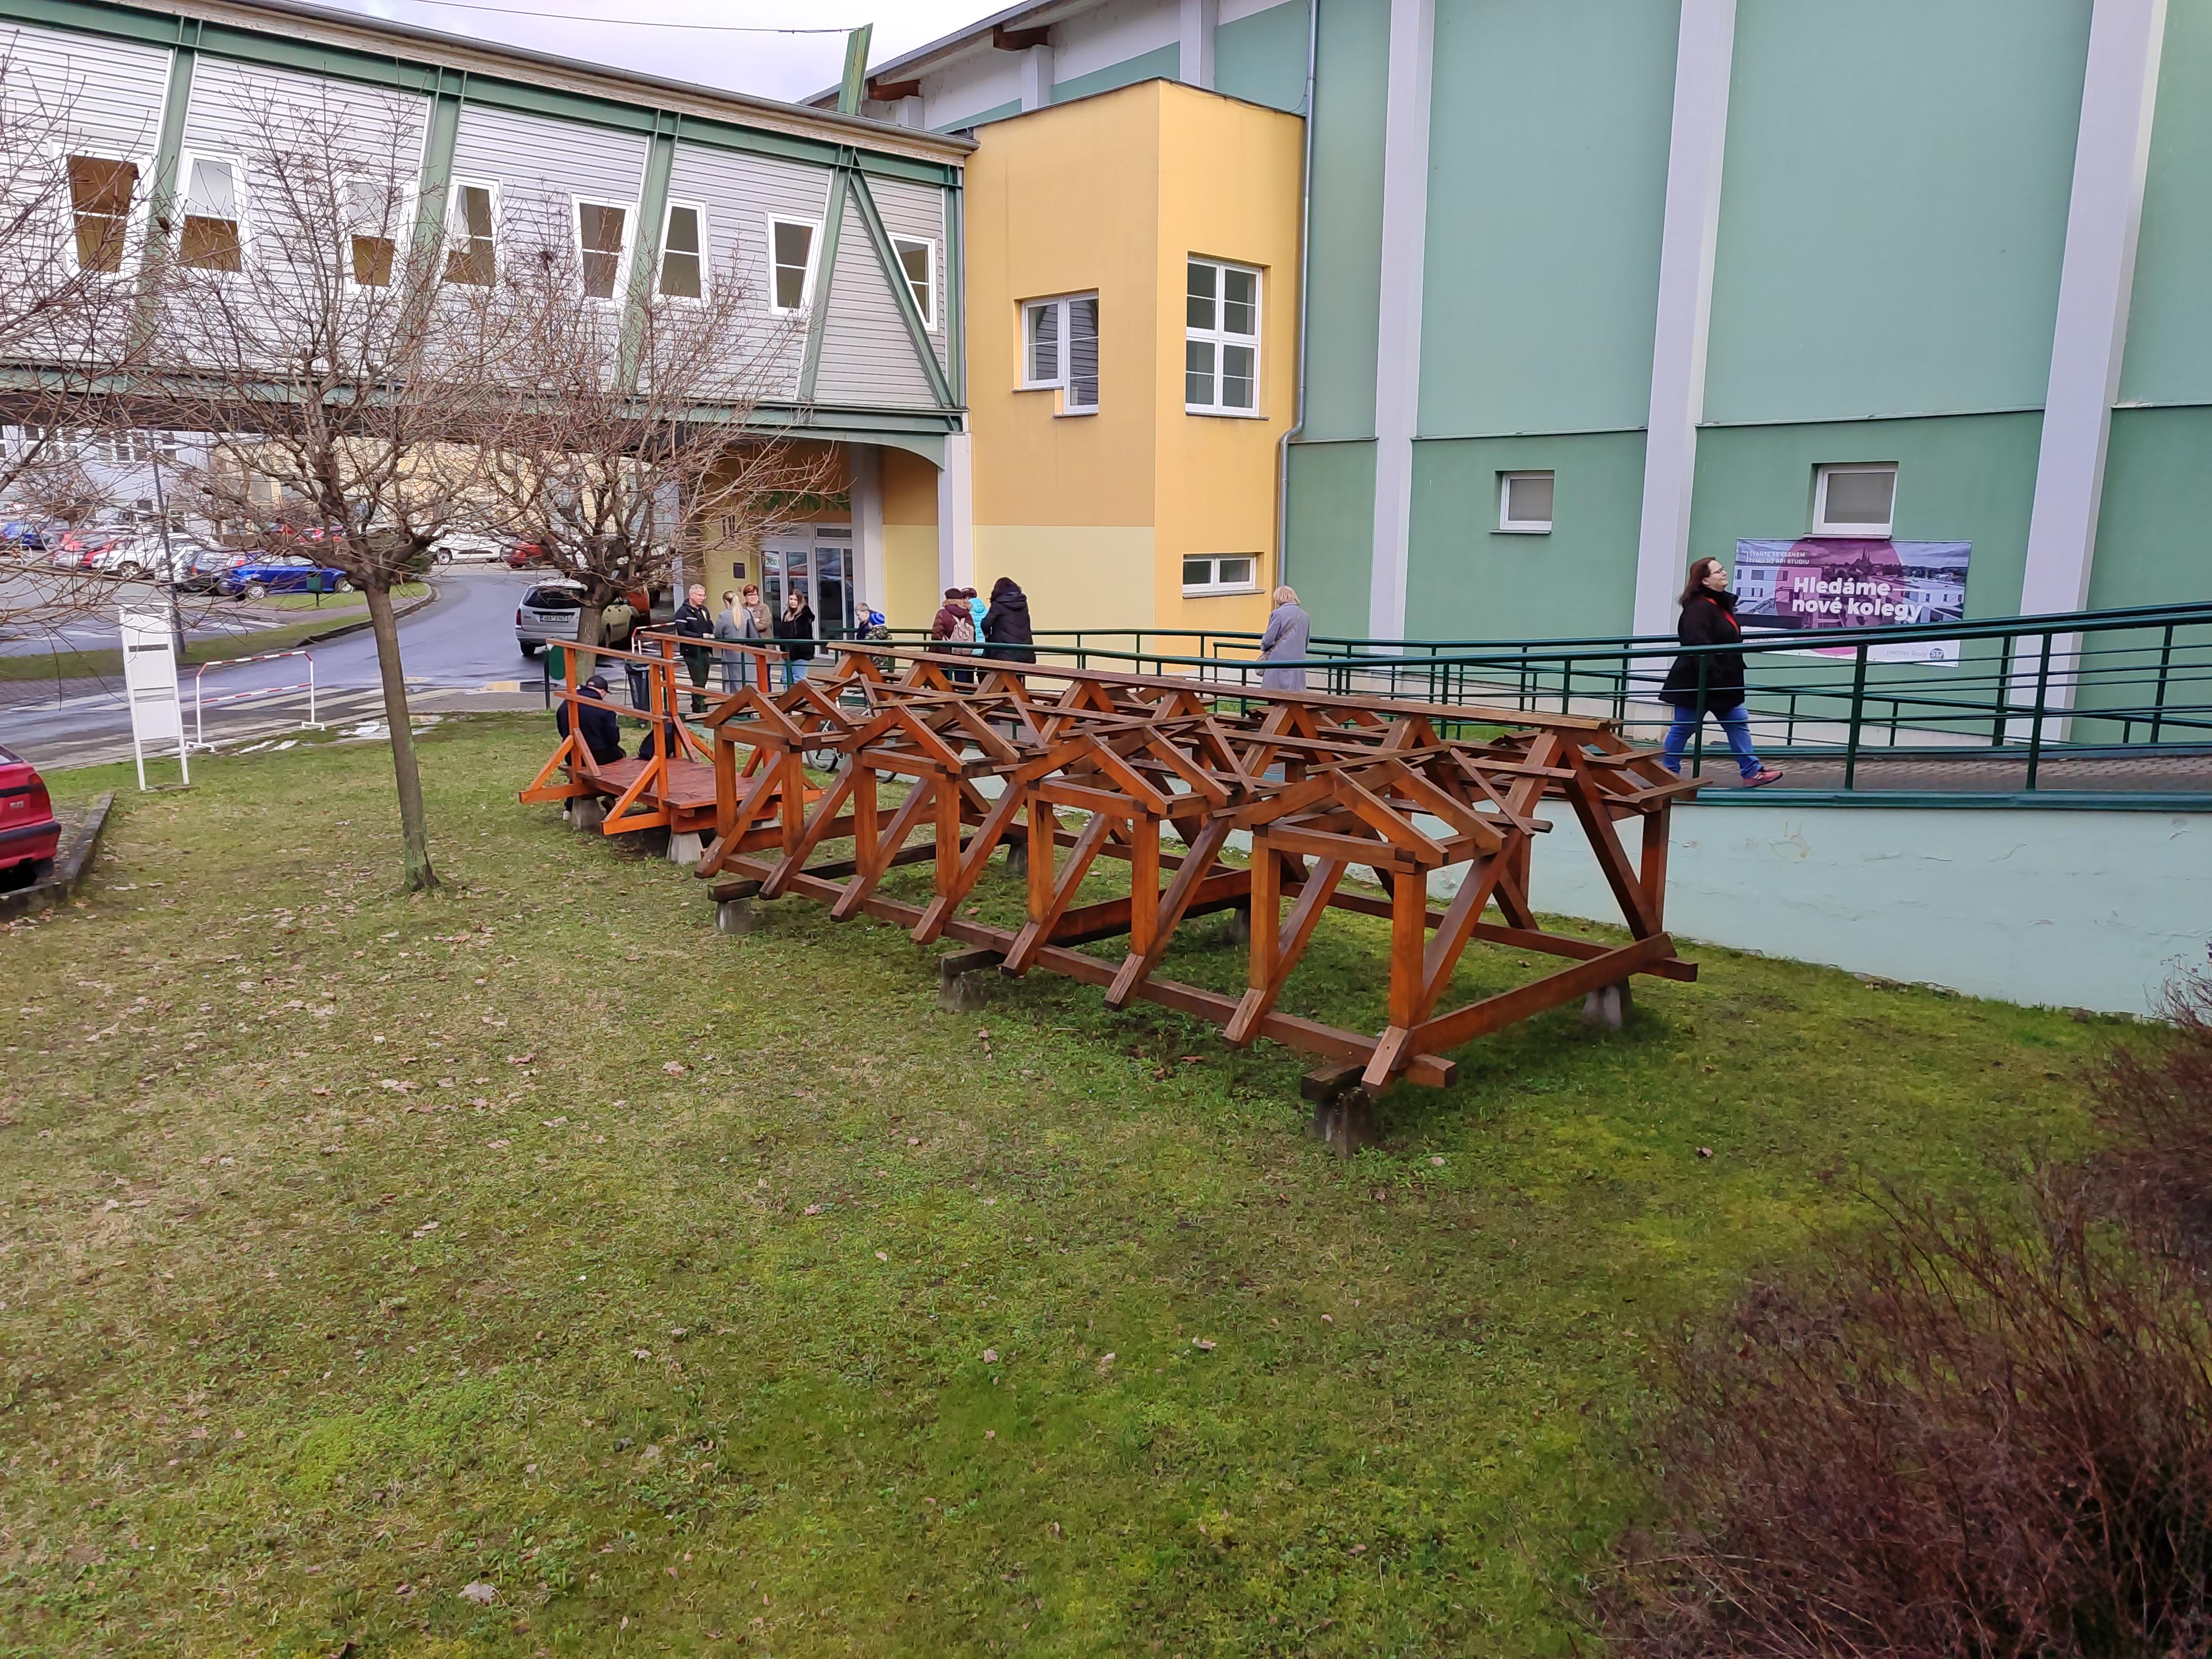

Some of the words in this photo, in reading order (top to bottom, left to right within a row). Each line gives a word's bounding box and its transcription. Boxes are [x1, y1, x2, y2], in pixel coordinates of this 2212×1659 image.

[1793, 577, 1891, 596] Hledáme
[1792, 597, 1842, 614] nové
[1847, 597, 1923, 621] kolegy
